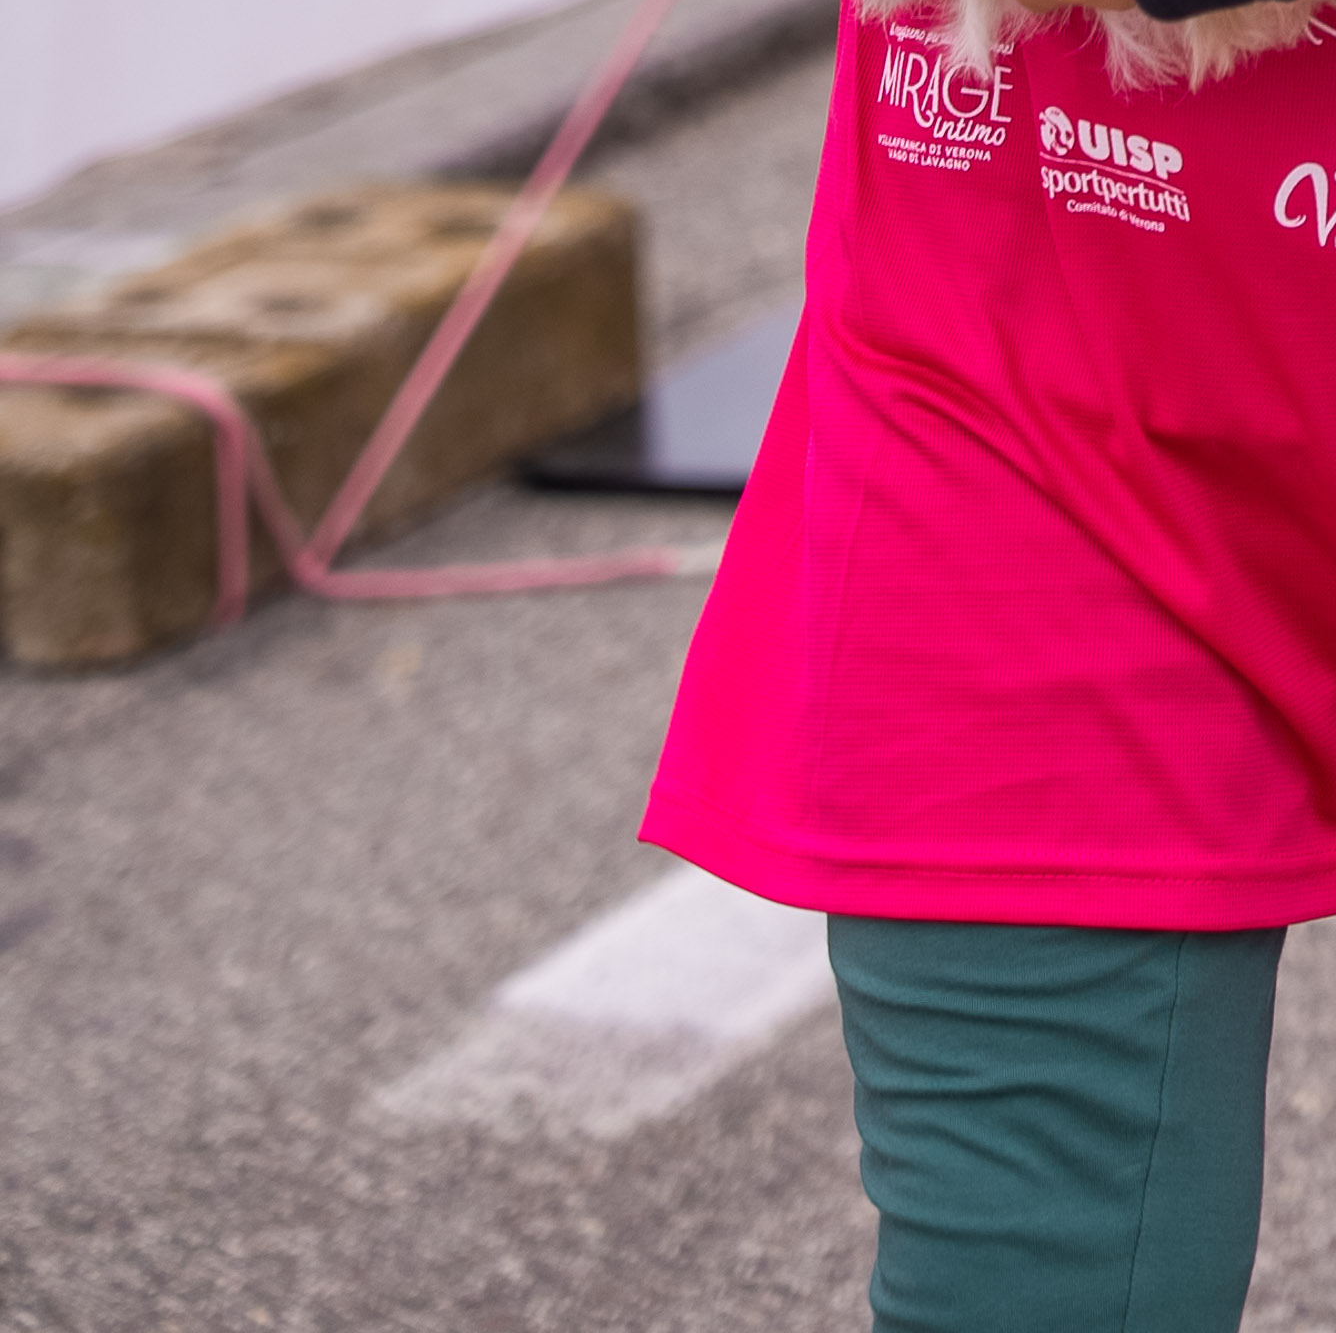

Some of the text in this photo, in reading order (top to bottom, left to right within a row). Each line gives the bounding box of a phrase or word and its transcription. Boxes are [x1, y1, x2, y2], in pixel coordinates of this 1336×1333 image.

[877, 44, 1013, 128] MIRAGE
[877, 134, 991, 162] VILLAFRANCA DI VERONA
[933, 116, 1006, 146] intimo
[888, 148, 971, 172] VAGO DI LAVAGNO
[1078, 119, 1183, 180] UISP
[1041, 166, 1190, 222] sportpertutti
[1066, 199, 1117, 218] Comitato
[1128, 212, 1165, 233] Verona
